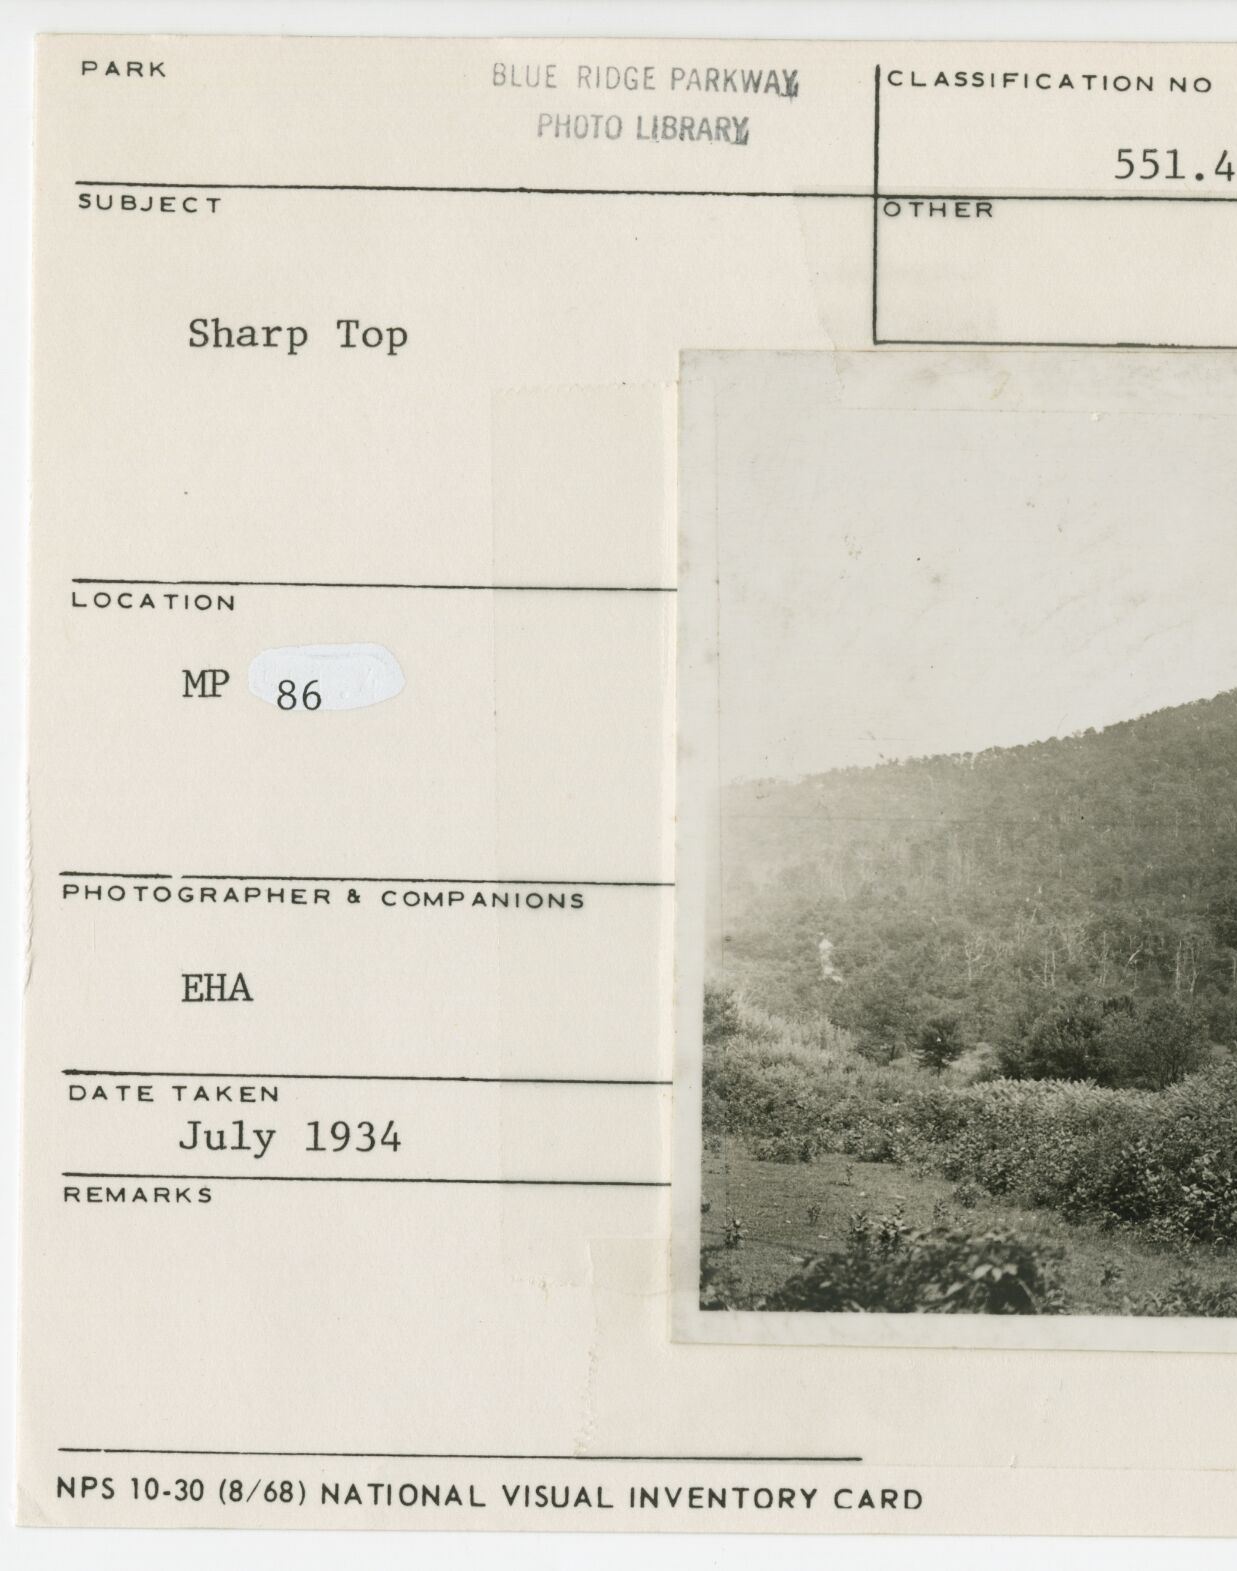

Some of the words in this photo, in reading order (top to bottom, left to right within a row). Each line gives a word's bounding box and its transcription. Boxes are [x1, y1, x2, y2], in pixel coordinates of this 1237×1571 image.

[81, 60, 167, 78] PARK
[492, 62, 557, 89] BLUE
[578, 65, 656, 91] RIDGE
[670, 67, 800, 102] PARKWAY
[886, 69, 1154, 93] CLASSIFICATION
[1169, 76, 1213, 94] NO
[537, 113, 623, 140] PHOTO
[636, 115, 750, 146] LIBRARY
[1114, 147, 1236, 183] 551.4
[77, 192, 222, 214] SUBJECT
[884, 200, 993, 219] OTHER
[188, 316, 309, 356] Sharp
[336, 318, 409, 357] Top
[71, 591, 235, 612] LOCATION
[181, 668, 231, 699] MP
[276, 678, 323, 712] 86
[62, 883, 331, 906] PHOTOGRAPHER
[346, 887, 361, 905] &
[380, 889, 585, 910] COMPANIONS
[180, 971, 255, 1003] EHA
[68, 1084, 155, 1103] DATE
[171, 1084, 279, 1104] TAKEN
[178, 1119, 277, 1160] July
[305, 1119, 402, 1153] 1934
[63, 1185, 212, 1204] REMARKS
[56, 1475, 116, 1501] NPS
[130, 1476, 205, 1502] 10-30
[218, 1477, 307, 1507] (8/68)
[320, 1482, 487, 1508] NATIONAL
[501, 1483, 615, 1509] VISUAL
[629, 1485, 818, 1510] INVENTORY
[833, 1487, 923, 1511] CARD
